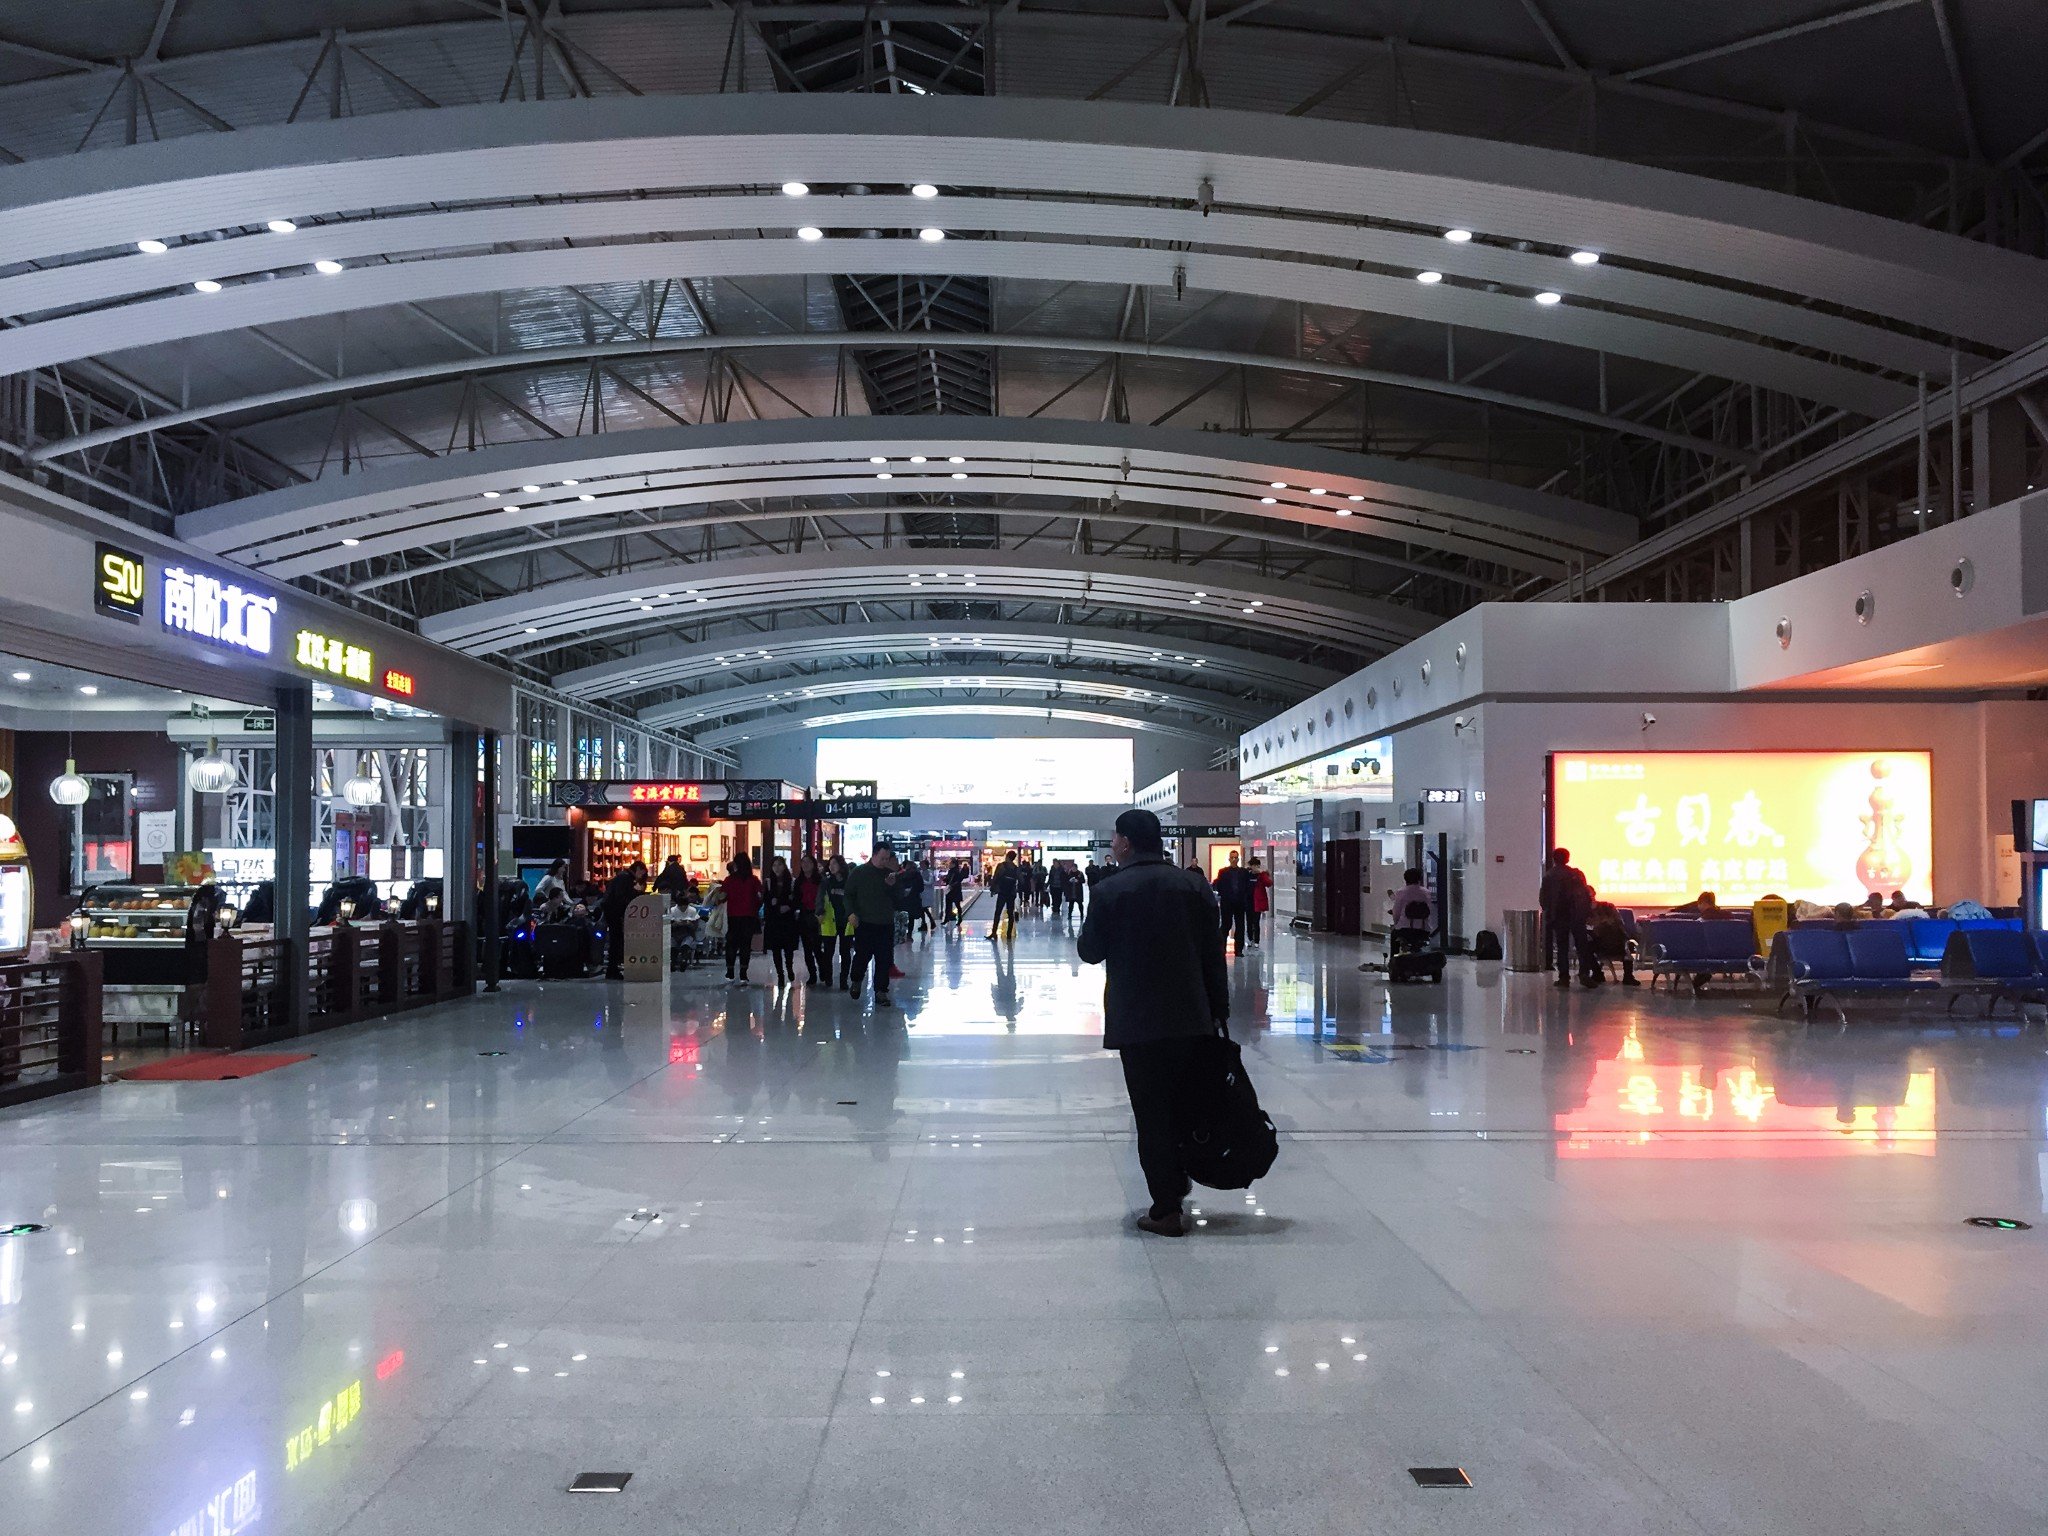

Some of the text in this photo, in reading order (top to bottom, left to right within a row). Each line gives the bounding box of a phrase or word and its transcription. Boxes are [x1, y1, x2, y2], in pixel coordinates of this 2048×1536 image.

[772, 802, 786, 815] 12
[825, 803, 854, 815] 04-11
[1168, 827, 1186, 835] 05-11
